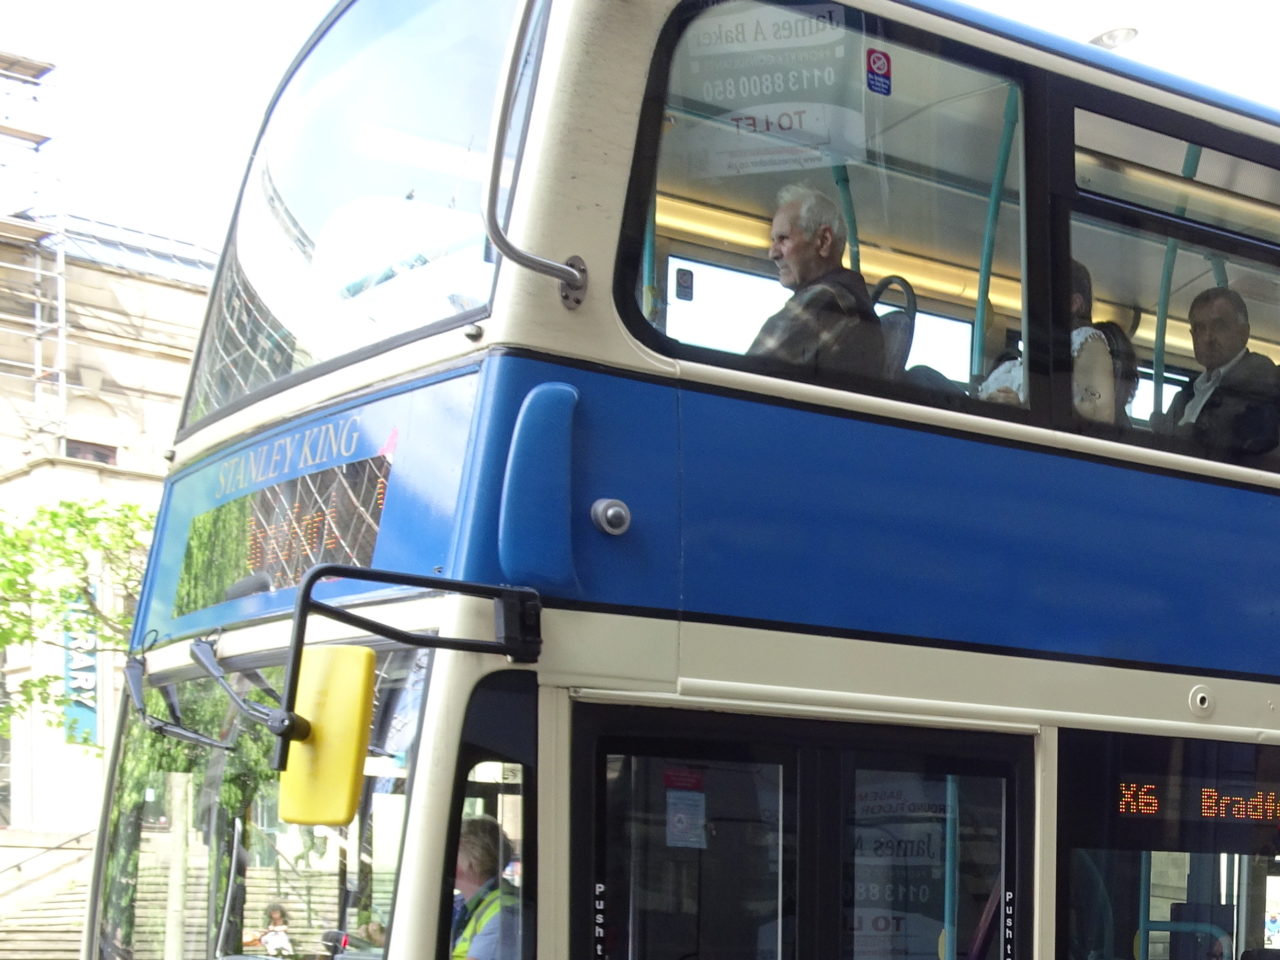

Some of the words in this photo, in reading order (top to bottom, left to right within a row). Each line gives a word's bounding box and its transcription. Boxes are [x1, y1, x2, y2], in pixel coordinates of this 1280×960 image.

[216, 433, 300, 499] STANLEY
[298, 416, 361, 469] KING
[1119, 783, 1158, 814] X6
[595, 883, 605, 937] Push
[1005, 891, 1013, 939] Push
